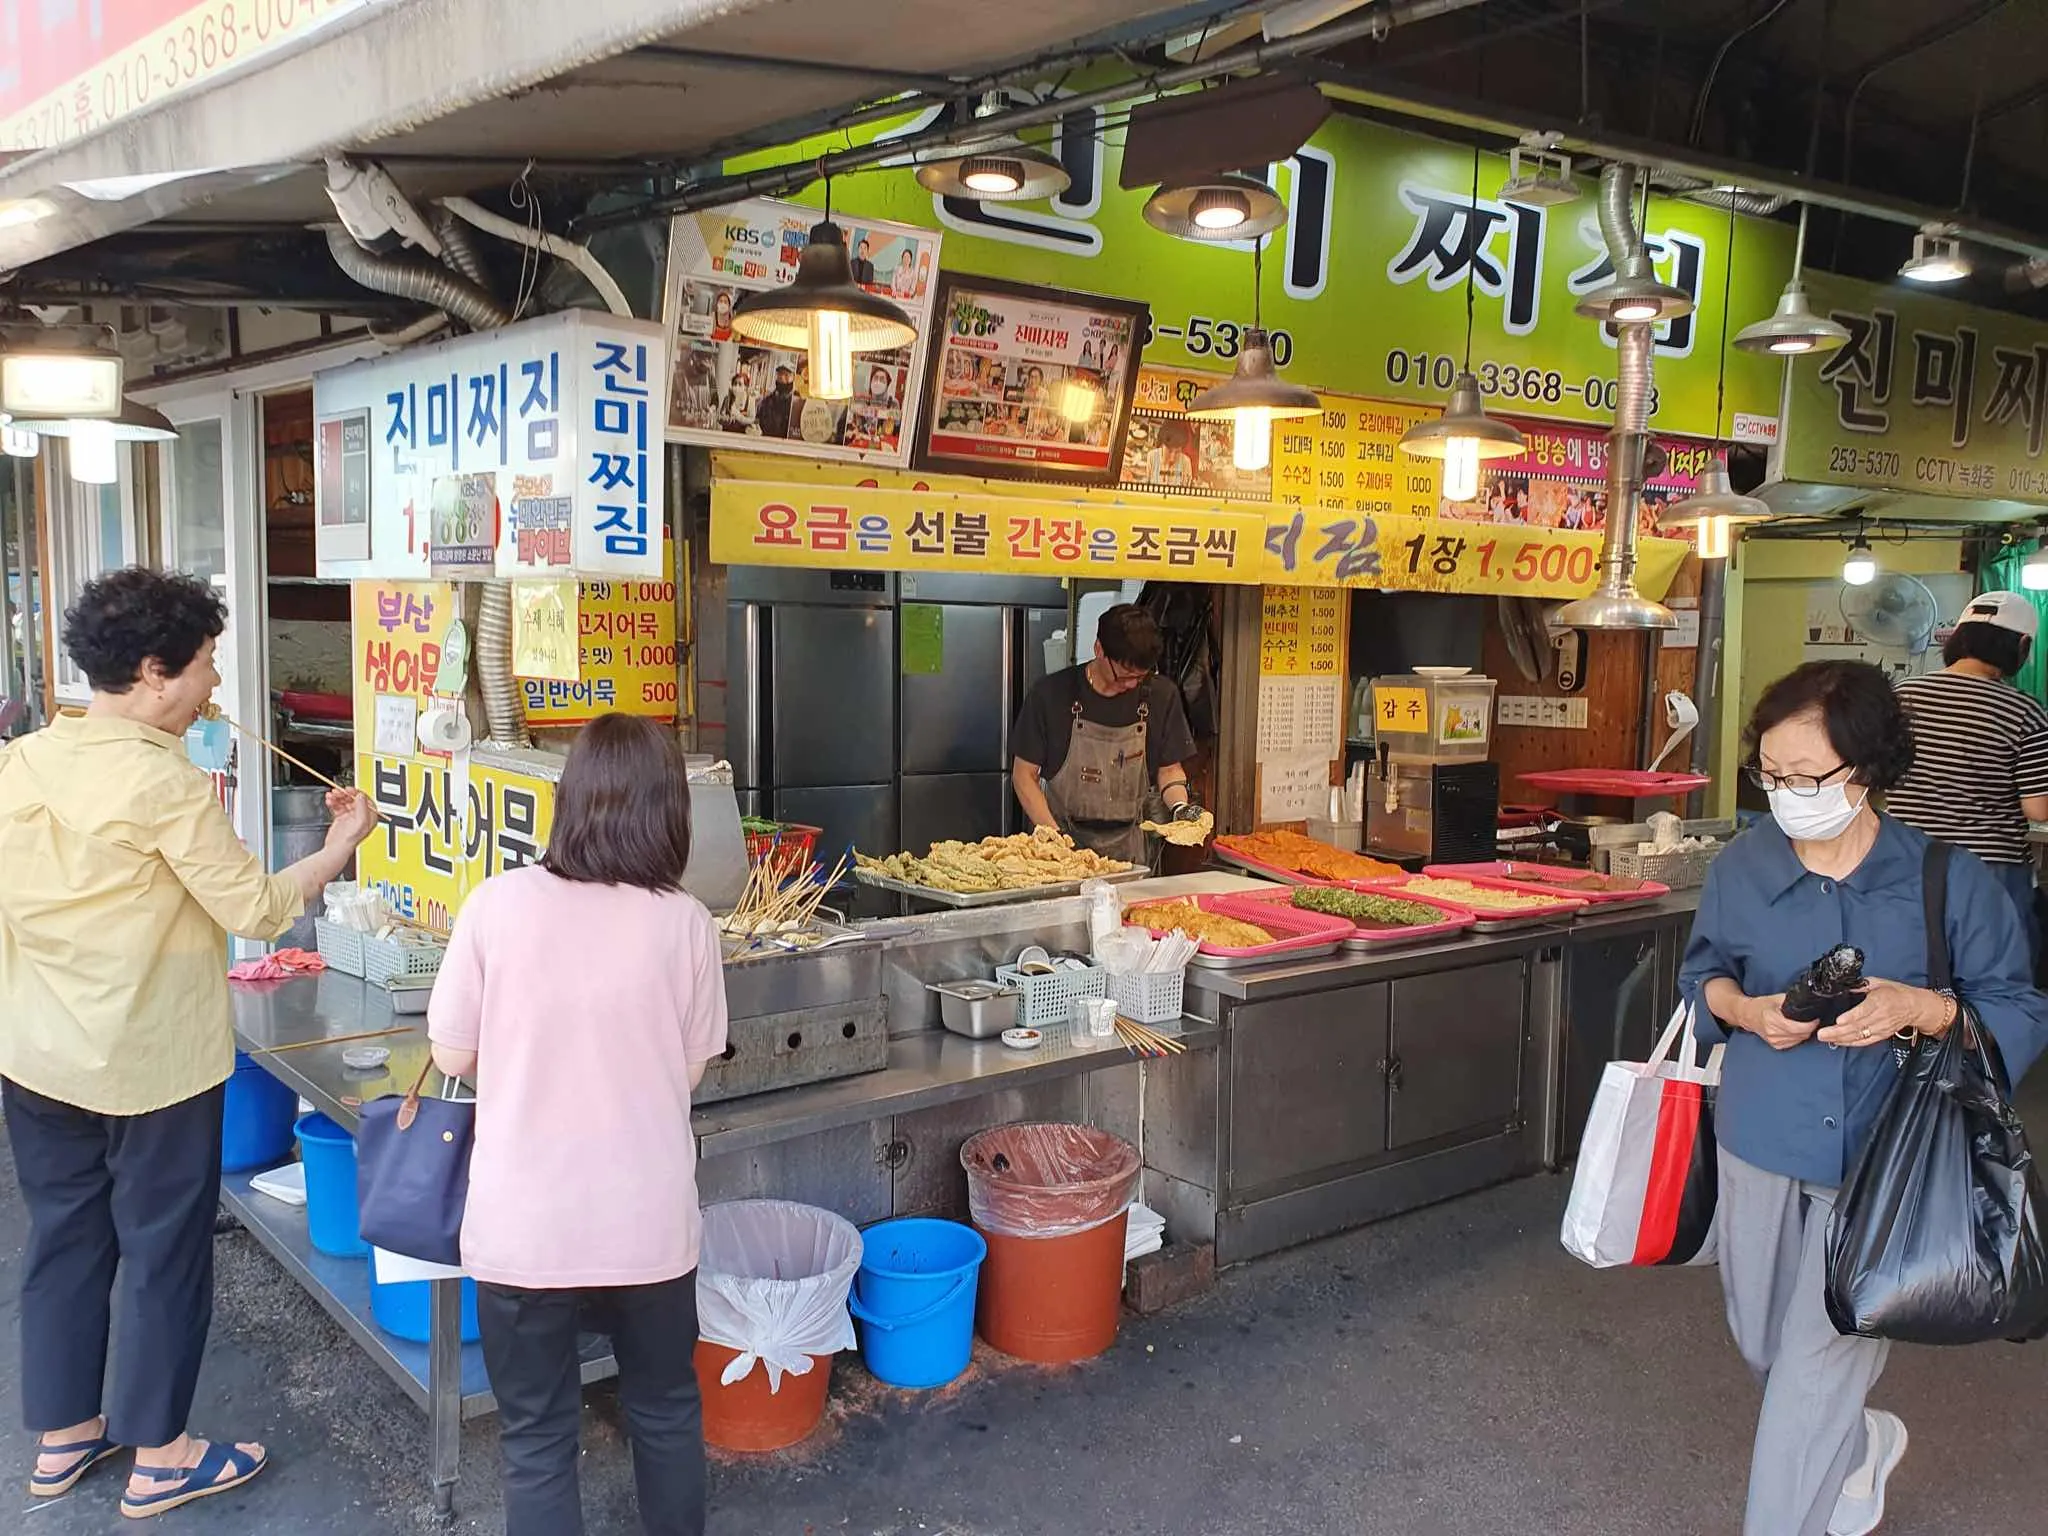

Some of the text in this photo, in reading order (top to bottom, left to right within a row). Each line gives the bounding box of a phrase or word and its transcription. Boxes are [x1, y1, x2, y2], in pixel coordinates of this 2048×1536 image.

[102, 0, 342, 120] 010-3368-00
[725, 224, 759, 245] KBS
[1386, 350, 1660, 415] 010-3368-003
[1819, 308, 2048, 457] 진미찌
[386, 351, 560, 474] 진미찌짐
[1358, 412, 1404, 436] 오징어튀김
[588, 341, 649, 556] 진미찌짐
[1283, 435, 1312, 455] 빈대떡
[1356, 441, 1394, 463] 고추튀김
[1282, 464, 1312, 486] 수수전
[1356, 471, 1393, 491] 수제어묵
[1829, 446, 1900, 478] 253-5370
[1915, 457, 1955, 483] CCTV
[1959, 465, 1996, 490] 녹화중
[518, 528, 572, 566] 라이브
[752, 502, 1238, 569] 요금은 선불 간장은 조금씩
[1403, 532, 1466, 576] 1장
[1476, 538, 1593, 585] 1,500
[621, 581, 675, 604] 1,000
[376, 590, 434, 633] 부산
[1264, 604, 1299, 618] 배추전
[622, 645, 676, 668] 1,000
[1263, 640, 1298, 653] 수수전
[365, 639, 441, 697] 생어묵
[525, 678, 677, 709] 일반어묵 500
